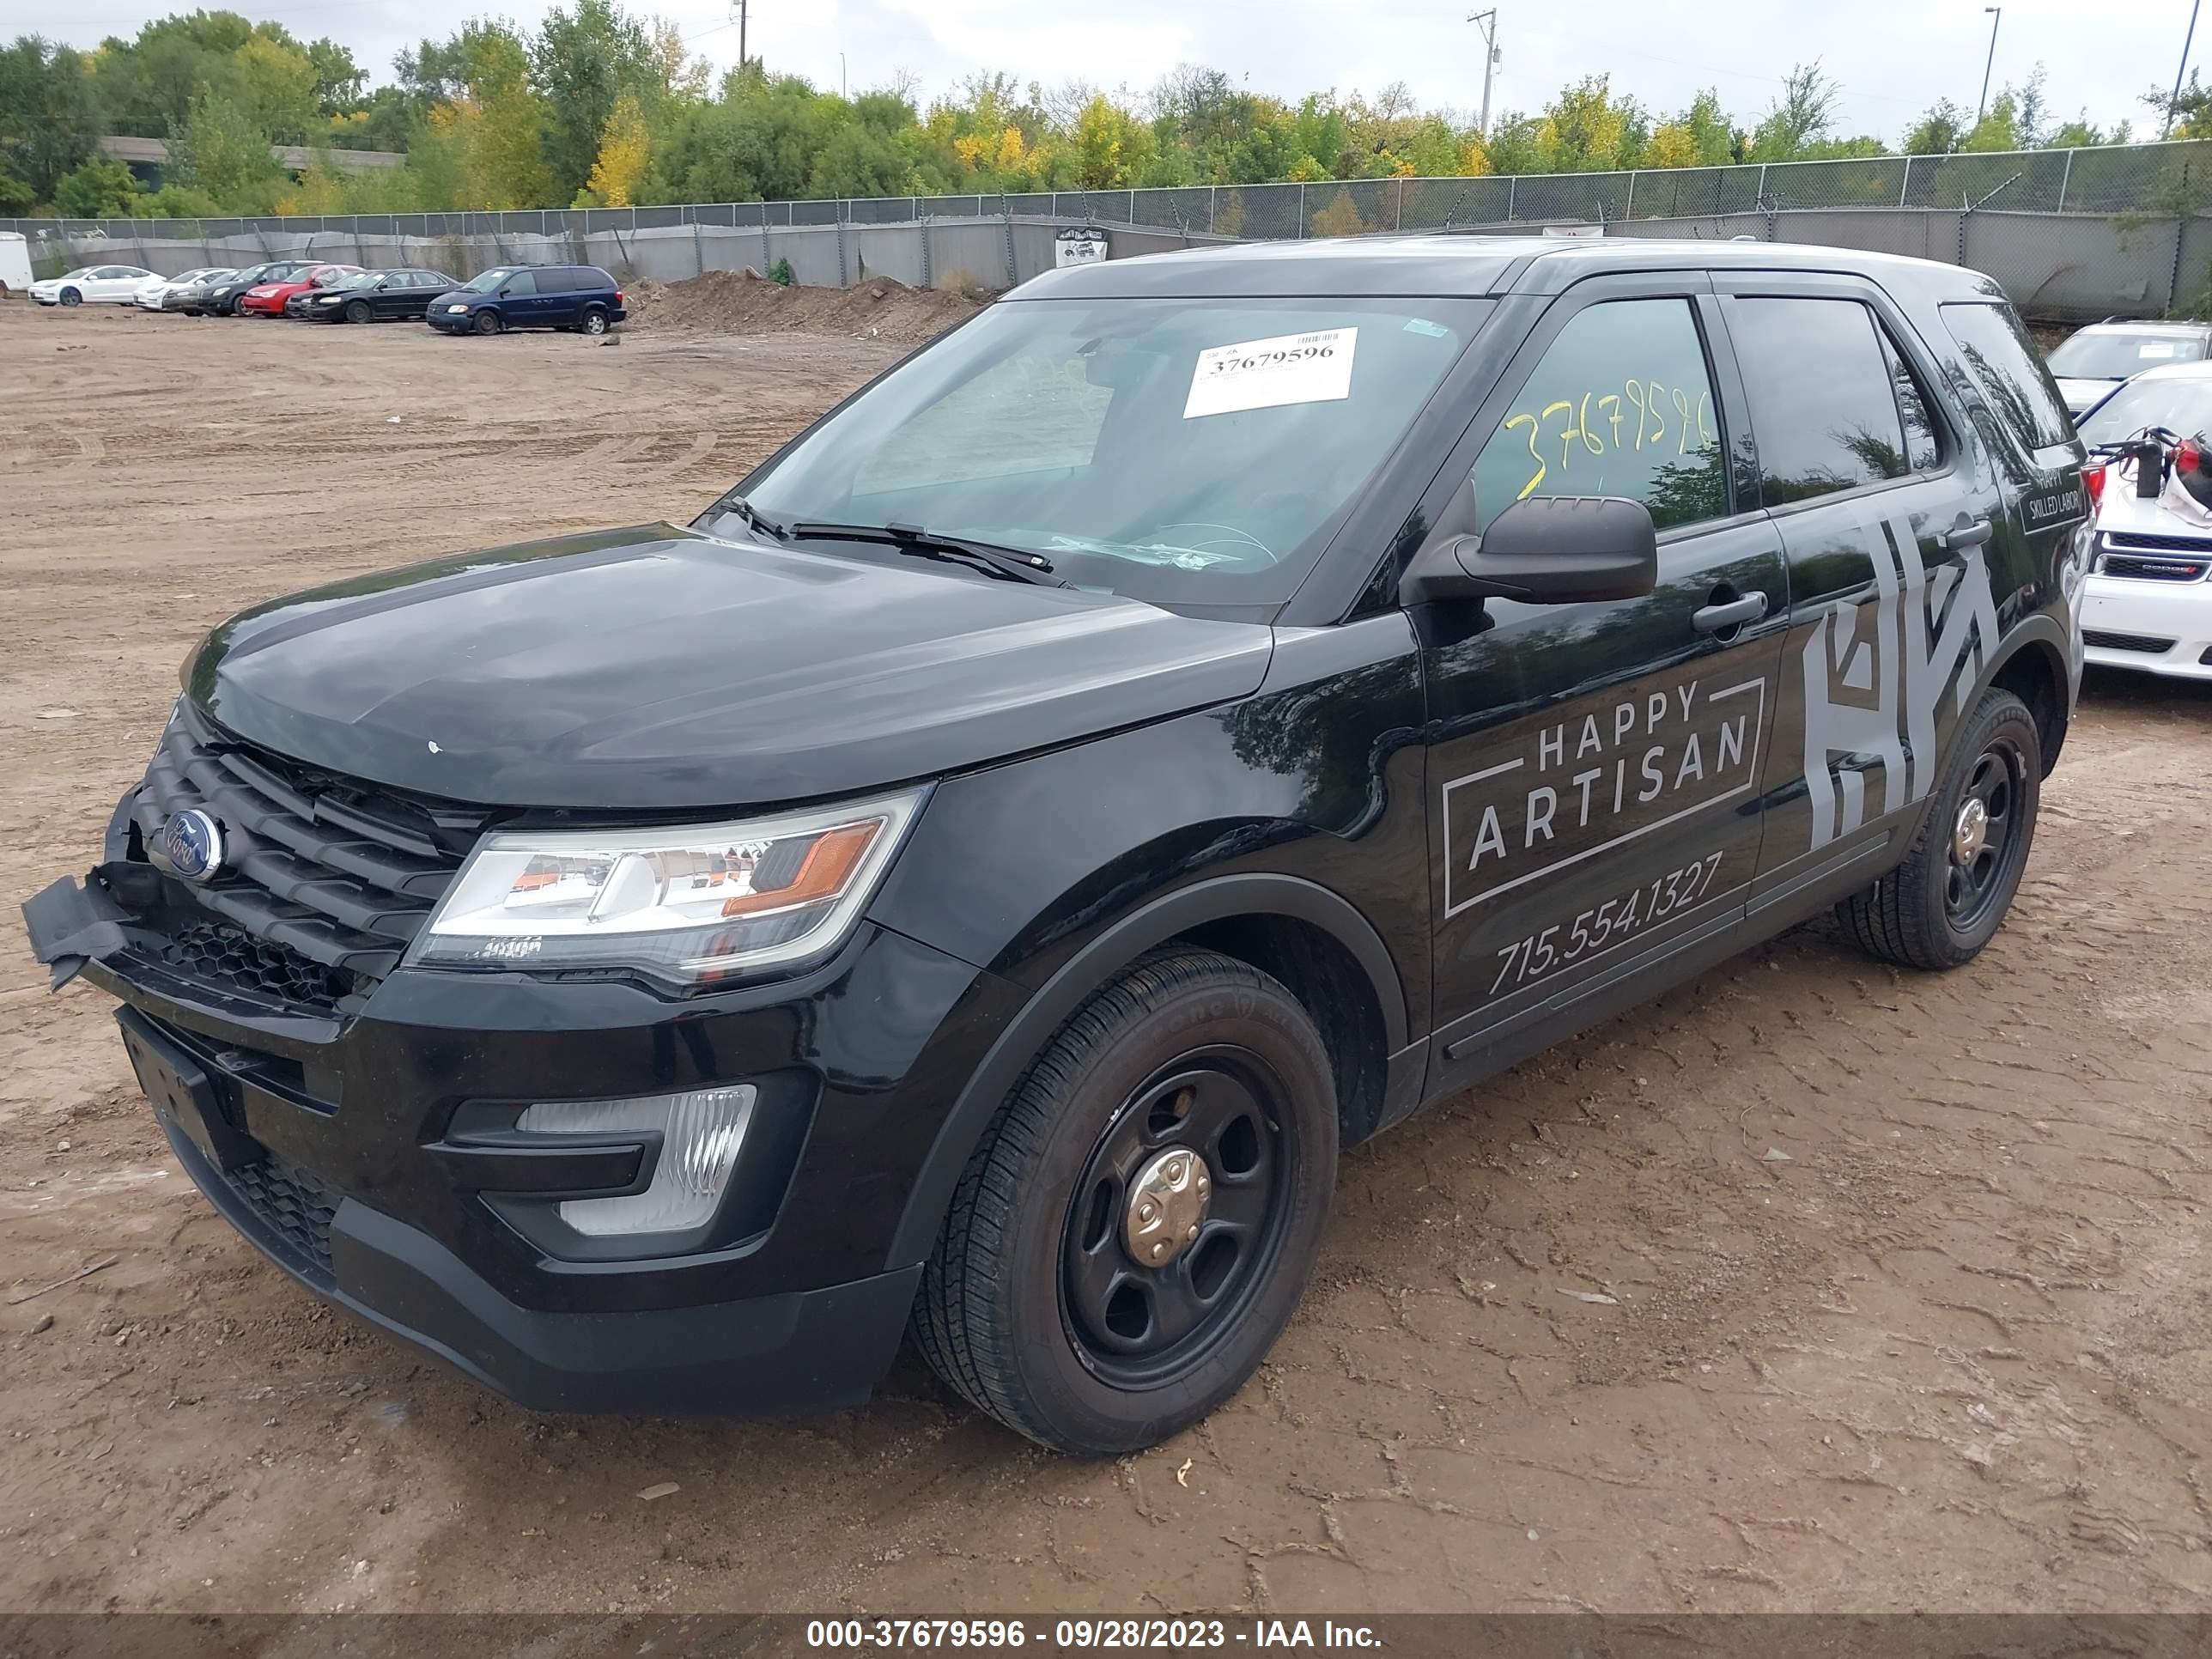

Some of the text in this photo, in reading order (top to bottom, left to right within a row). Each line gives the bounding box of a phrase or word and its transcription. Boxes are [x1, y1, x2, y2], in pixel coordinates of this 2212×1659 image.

[1209, 345, 1334, 375] 37679596
[1505, 379, 1711, 501] 37679596
[2029, 490, 2079, 520] SKILLED LABOR
[1539, 680, 1698, 772] HAPPY
[1468, 714, 1746, 871] ARTISAN
[167, 817, 200, 866] Ford
[1489, 850, 1723, 995] 715.554.1327
